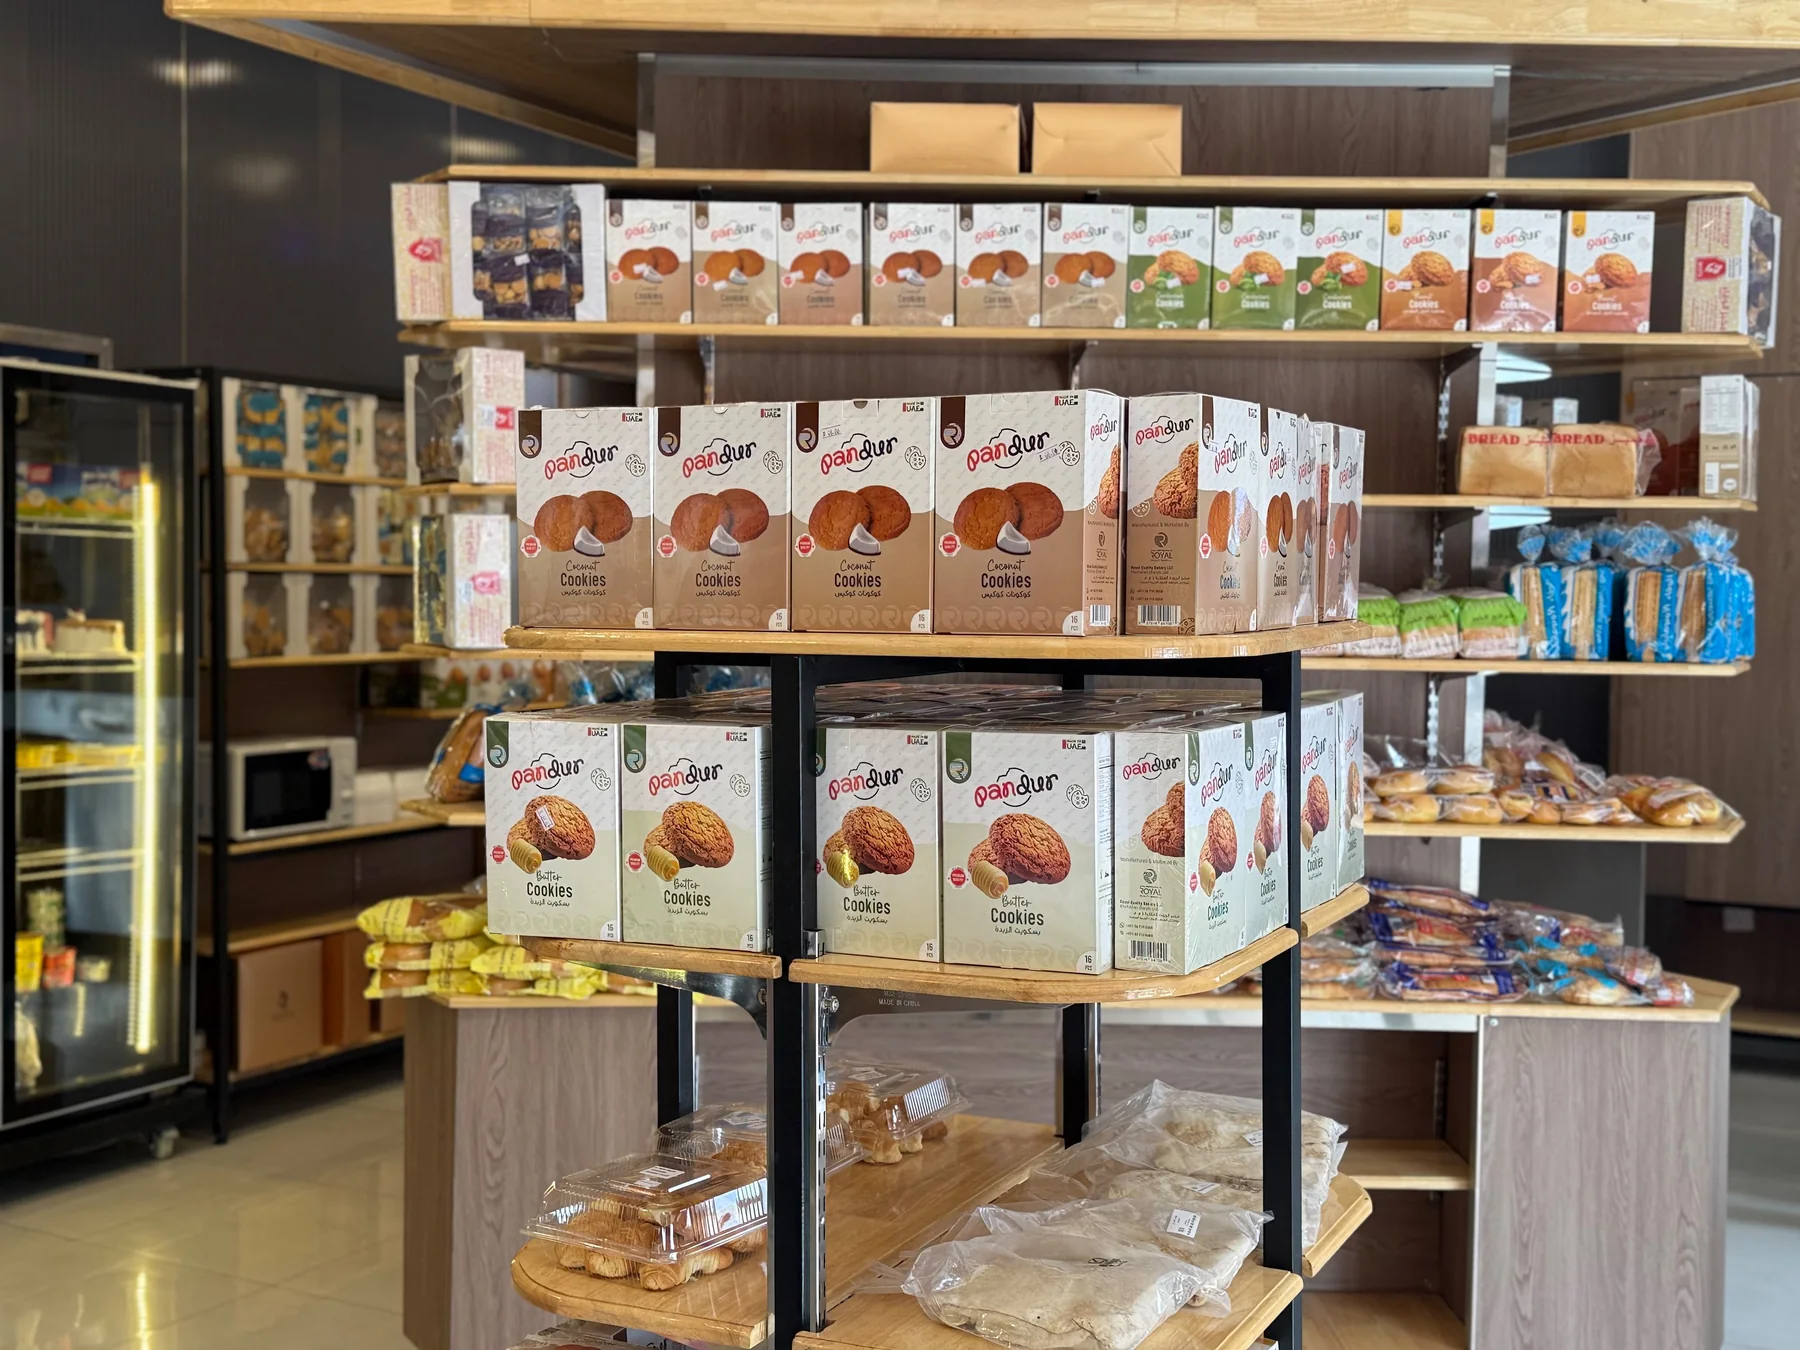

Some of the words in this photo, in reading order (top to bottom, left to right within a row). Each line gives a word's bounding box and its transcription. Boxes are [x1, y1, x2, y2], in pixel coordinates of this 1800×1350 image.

[1135, 418, 1194, 446] pandur
[1468, 433, 1520, 446] BREAD
[1552, 432, 1605, 445] BREAD
[820, 437, 898, 475] pandur
[967, 432, 1050, 472] pandur
[545, 445, 618, 480] pandur
[683, 442, 757, 478] pandur
[1151, 550, 1173, 559] ROYAL
[565, 560, 600, 572] Coconut
[700, 560, 735, 572] Coconut
[840, 559, 876, 572] Coconut
[987, 559, 1025, 572] Coconut
[560, 572, 606, 587] Cookies
[695, 572, 741, 587] Cookies
[834, 572, 882, 588] Cookies
[981, 572, 1032, 588] Cookies
[642, 611, 649, 619] 16
[918, 614, 925, 622] 16
[1071, 616, 1078, 624] 16
[512, 758, 584, 790] pandur
[1122, 757, 1180, 780] pandur
[648, 764, 723, 796] pandur
[828, 768, 904, 800] pandur
[1201, 764, 1234, 807] pandur
[974, 774, 1058, 808] pandur
[1307, 856, 1324, 874] Cookies
[536, 870, 562, 882] Butter
[526, 882, 573, 898] Cookies
[674, 878, 700, 890] Butter
[853, 885, 880, 897] Butter
[1140, 886, 1162, 896] ROYAL
[1260, 878, 1276, 898] Cookies
[664, 890, 711, 907] Cookies
[843, 896, 891, 914] Cookies
[1002, 894, 1032, 908] Butter
[990, 908, 1044, 926] Cookies
[1207, 901, 1229, 921] Cookies
[607, 924, 614, 932] 16
[747, 934, 754, 942] 16
[926, 942, 934, 951] 16
[1084, 955, 1092, 964] 16
